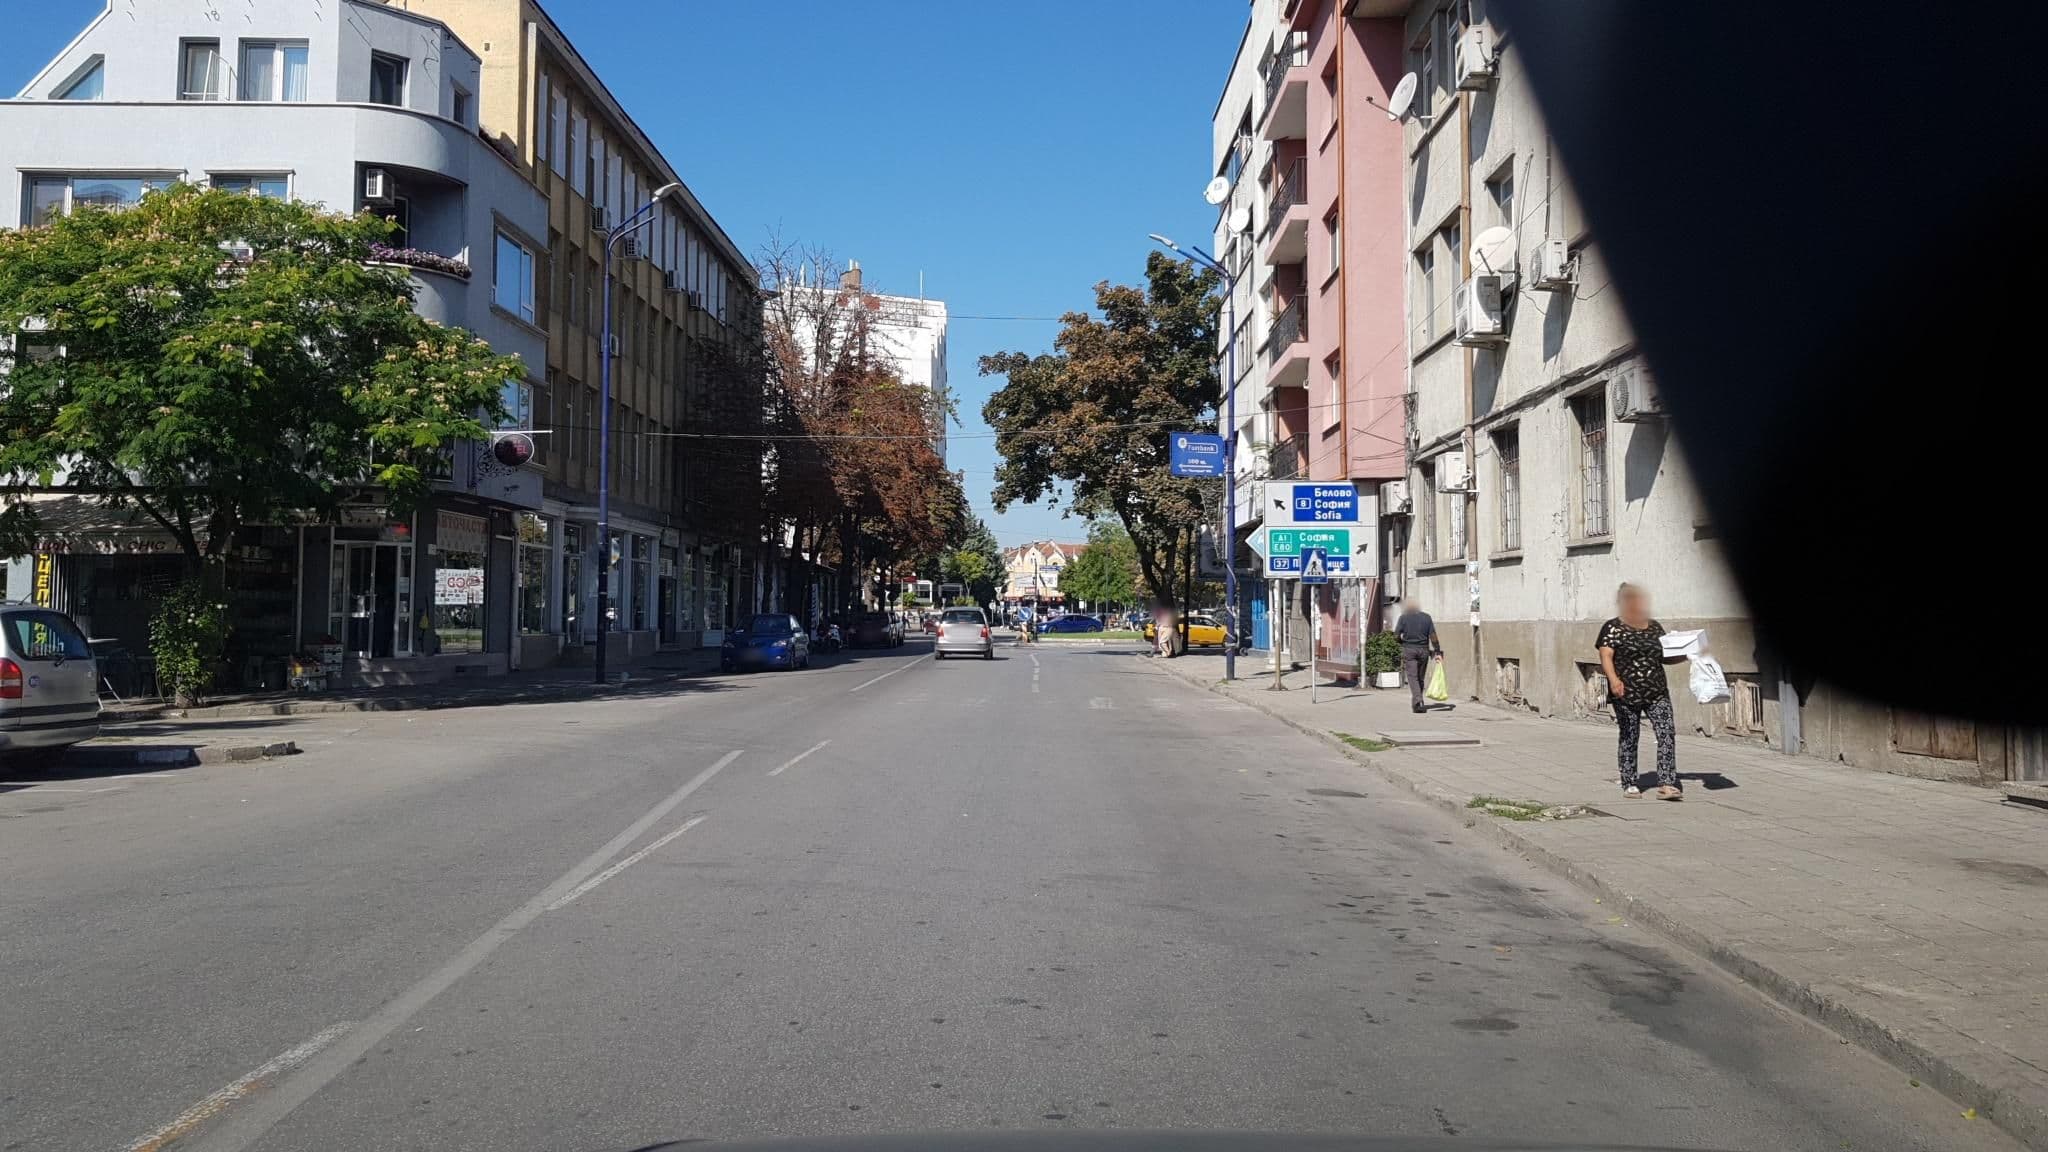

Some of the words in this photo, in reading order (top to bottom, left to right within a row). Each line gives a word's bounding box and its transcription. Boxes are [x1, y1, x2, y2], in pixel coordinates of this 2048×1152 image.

[1315, 488, 1352, 497] Белово
[1315, 500, 1351, 509] София
[1315, 511, 1342, 520] Sofia
[1299, 532, 1335, 541] София
[1276, 560, 1288, 568] 37
